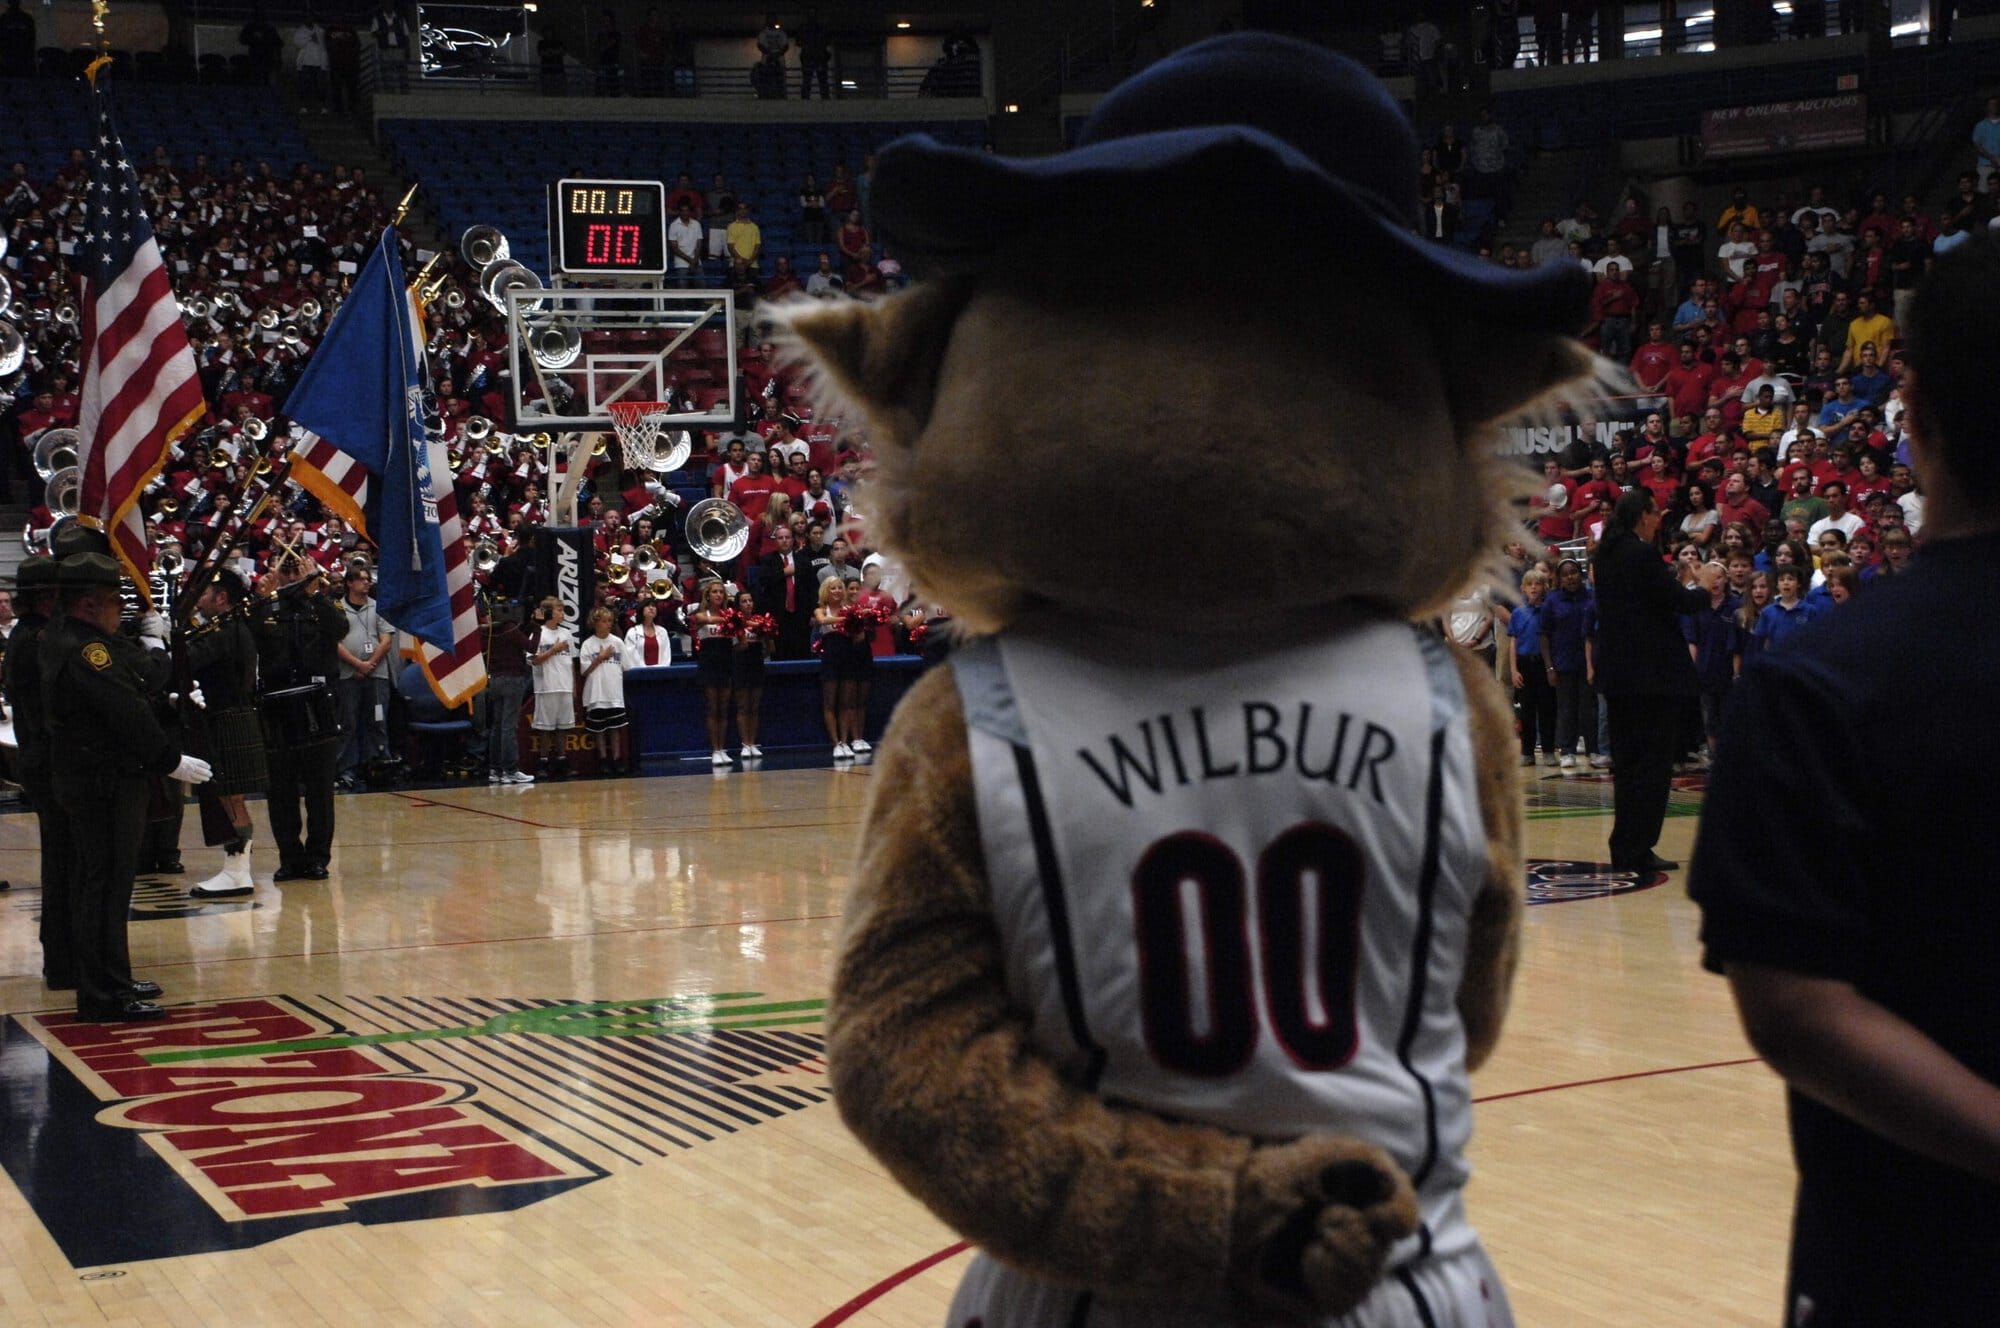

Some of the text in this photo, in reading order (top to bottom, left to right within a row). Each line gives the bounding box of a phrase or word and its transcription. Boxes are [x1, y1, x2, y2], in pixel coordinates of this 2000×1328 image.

[1711, 96, 1858, 121] NEW ONLINE AUCTIONS
[571, 188, 633, 214] 00.0
[586, 224, 640, 264] 00
[1497, 425, 1582, 455] MUSC
[1078, 702, 1395, 808] WILBUR
[1131, 820, 1364, 1079] 00
